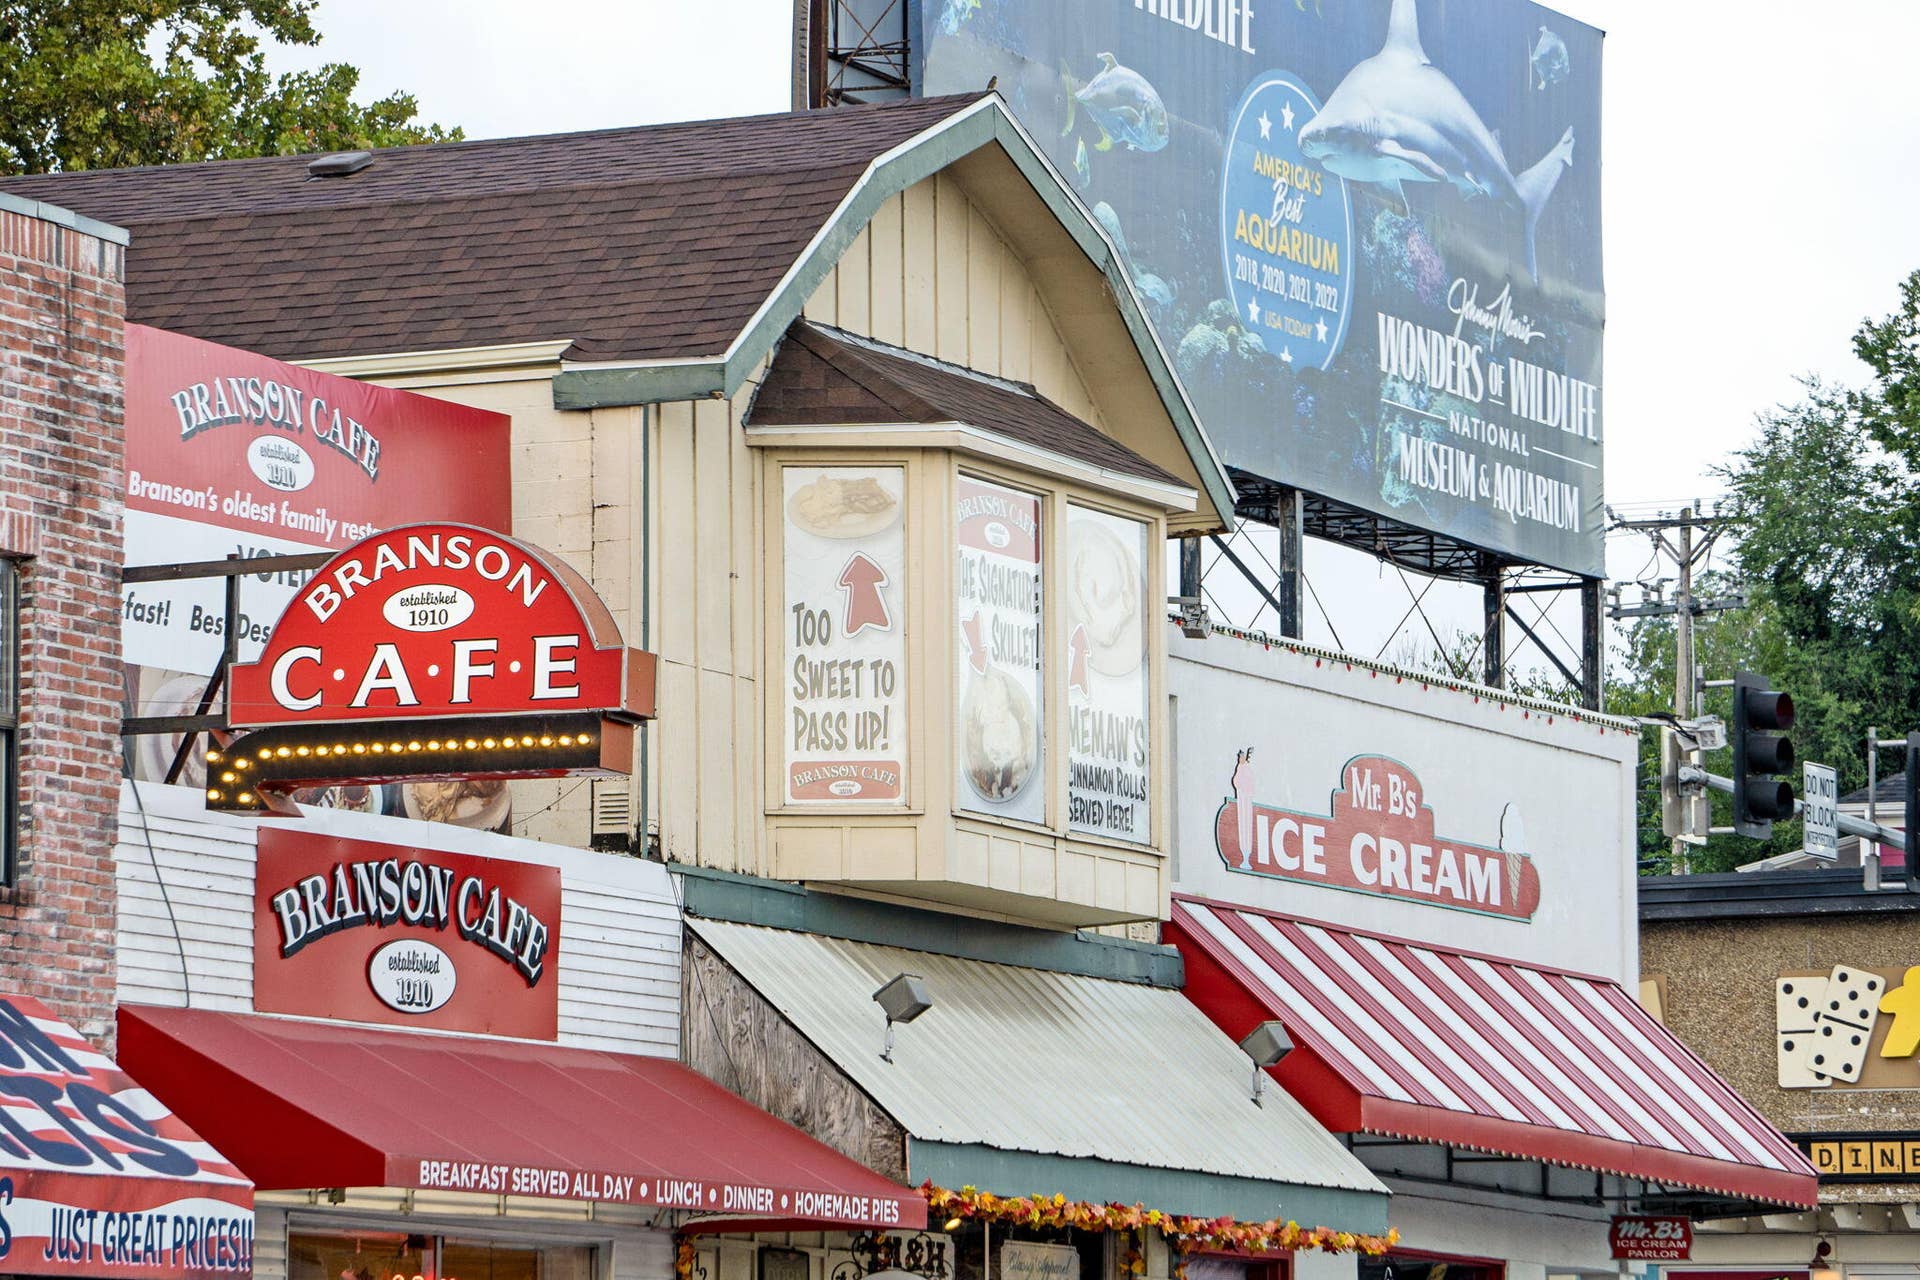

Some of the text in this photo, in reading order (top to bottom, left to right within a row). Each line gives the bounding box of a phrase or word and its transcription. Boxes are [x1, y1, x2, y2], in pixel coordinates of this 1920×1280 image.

[1253, 151, 1322, 196] AMERICA'S
[1271, 177, 1306, 228] Best
[1234, 208, 1339, 275] AQUARIUM
[1236, 253, 1338, 312] 2018, 2020, 2021, 2022
[1377, 312, 1598, 441] WONDERS OF WILDLIFE
[171, 376, 380, 484] BRANSON CAFE
[1449, 411, 1530, 457] NATIONAL
[1400, 433, 1580, 532] MUSEUM & AQUARIUM
[128, 470, 218, 512] Branson's
[222, 490, 276, 523] oldest
[280, 500, 338, 542] family
[960, 496, 1008, 522] BRANSON
[304, 533, 549, 624] BRANSON
[400, 591, 458, 608] established
[122, 591, 171, 626] fast!
[190, 604, 226, 635] Bes
[409, 608, 449, 626] 1910
[793, 602, 831, 647] TOO
[992, 612, 1039, 671] SKILLET!
[793, 654, 895, 700] SWEET TO
[793, 705, 889, 752] PASS UP!
[793, 765, 897, 787] BRANSON CAFE
[1117, 767, 1146, 801] ROLLS
[1351, 766, 1417, 819] Mr. B's
[1806, 774, 1834, 799] DO NOT
[1107, 799, 1134, 832] HERE!
[1806, 804, 1836, 828] BLOCK
[1256, 815, 1500, 906] ICE CREAM
[273, 858, 549, 988] BRANSON CAFE
[388, 952, 441, 974] established
[396, 978, 433, 1007] 1910
[420, 1160, 899, 1223] BREAKFAST SERVED ALL DAY LUNCH DINNER HOMEMADE PIES
[45, 1208, 97, 1260] JUST
[103, 1212, 167, 1264] GREAT
[172, 1215, 253, 1269] PRICES!!
[1617, 1240, 1687, 1249] ICE CREAM
[1618, 1221, 1683, 1239] Mr. B's
[1628, 1249, 1679, 1258] PARLOR
